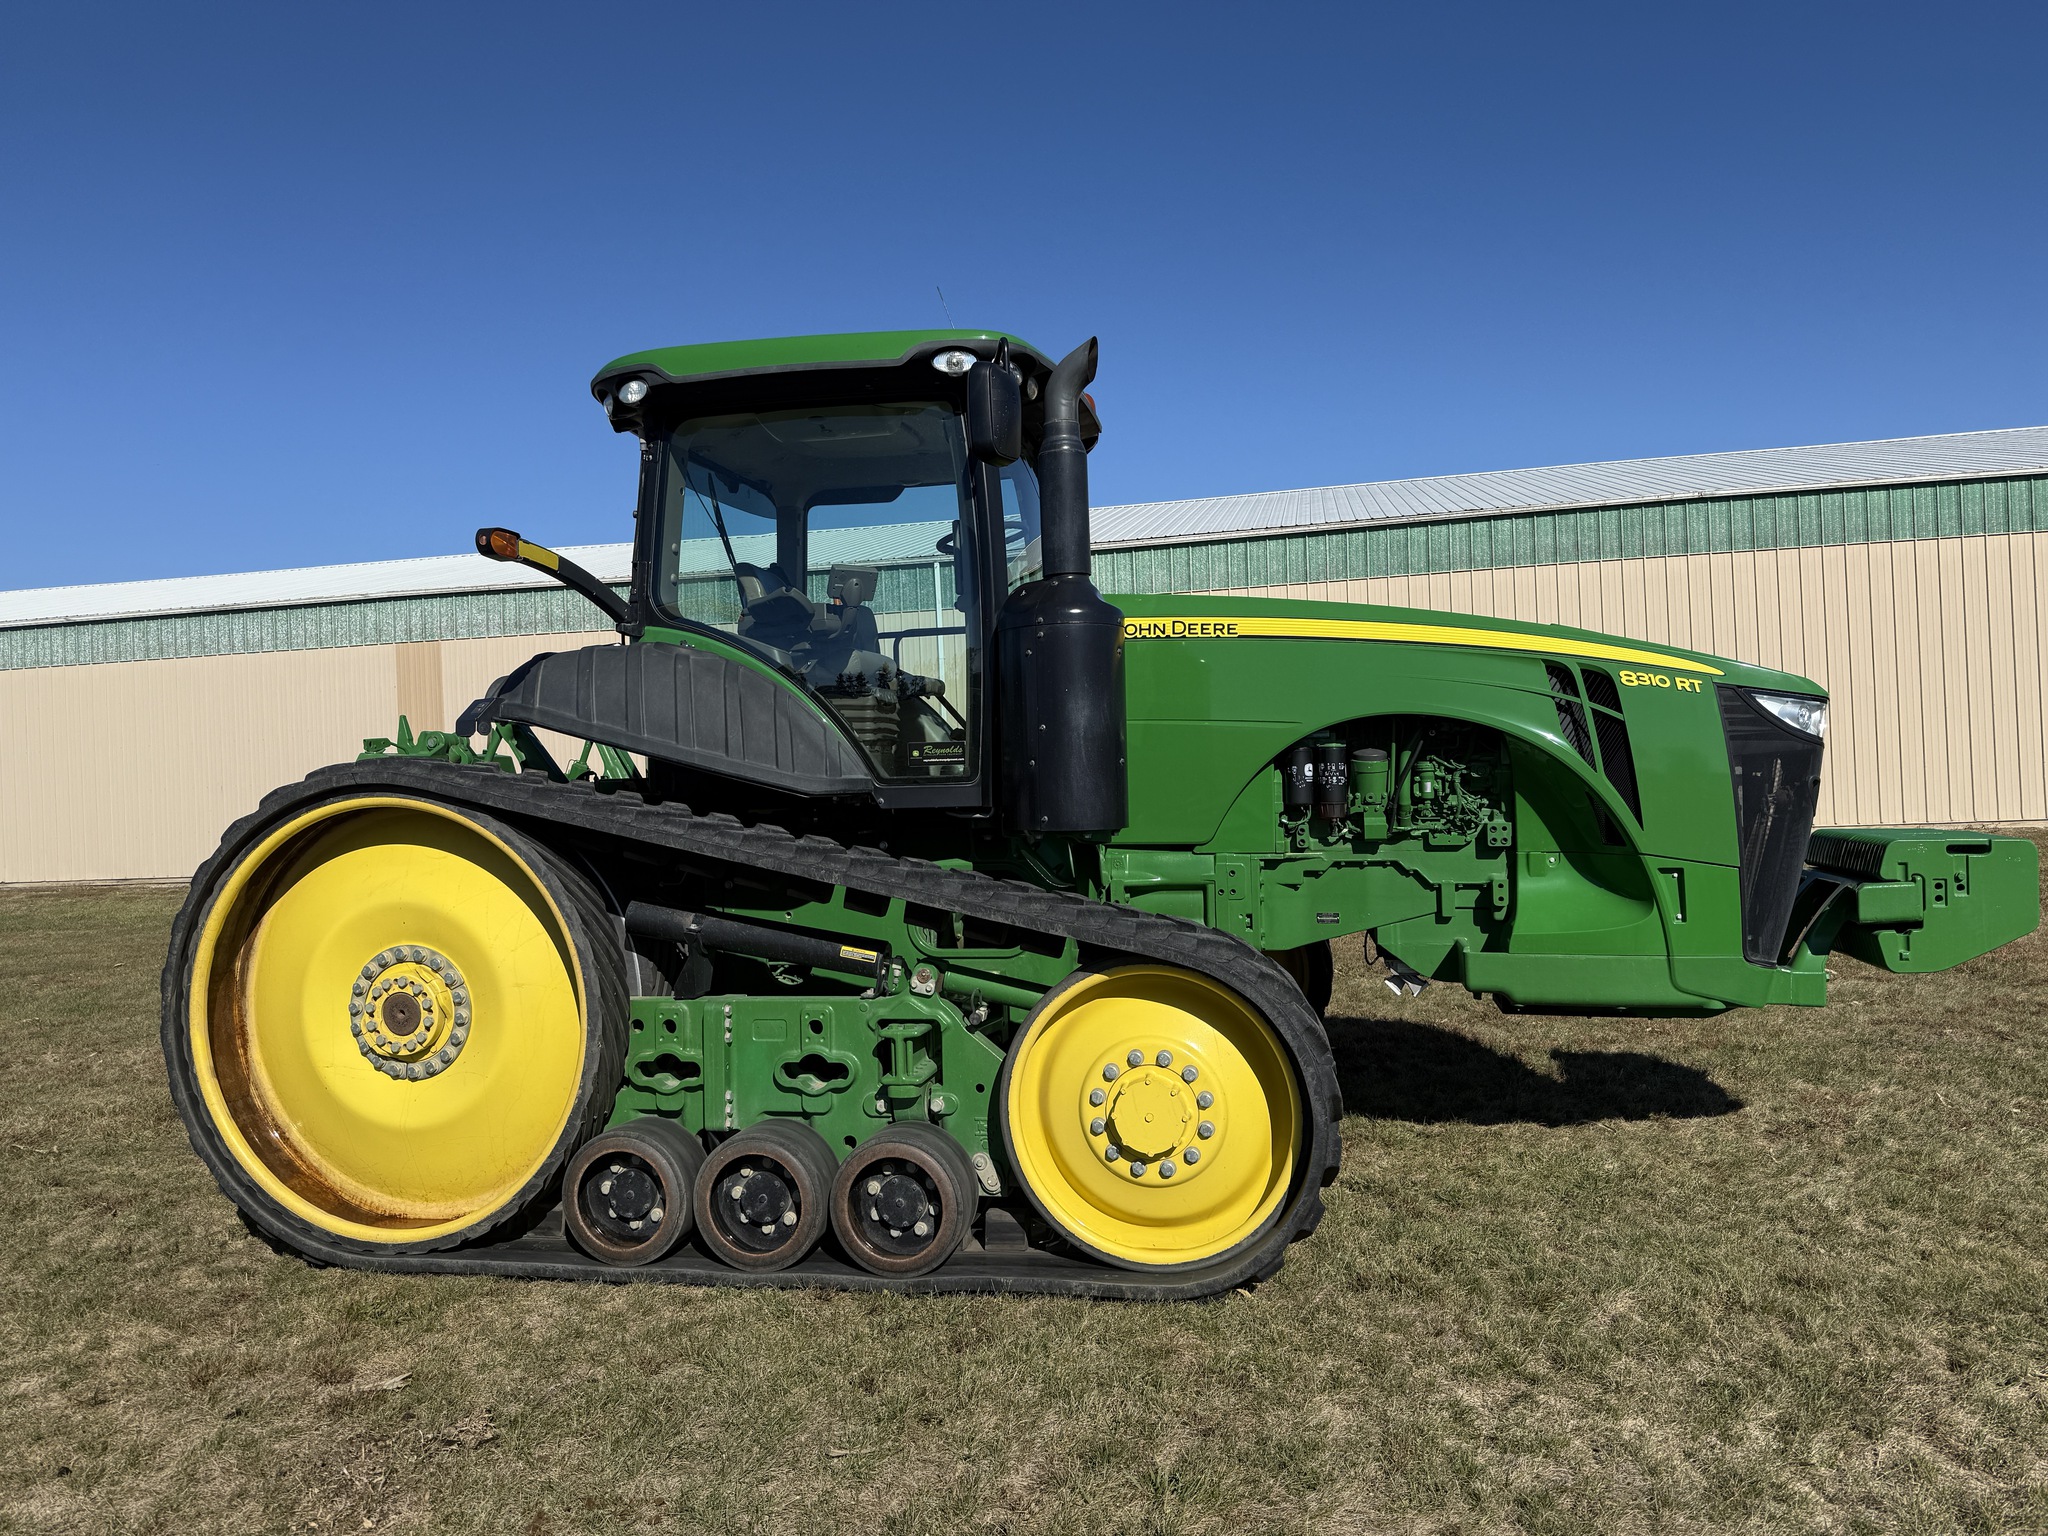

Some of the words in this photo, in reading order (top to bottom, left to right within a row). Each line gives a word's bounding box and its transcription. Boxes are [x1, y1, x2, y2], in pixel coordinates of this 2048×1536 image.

[1124, 623, 1166, 636] OHN
[1172, 620, 1239, 635] DEERE
[1619, 670, 1671, 688] 8310
[1674, 676, 1703, 694] RT
[922, 745, 963, 756] Reynolds
